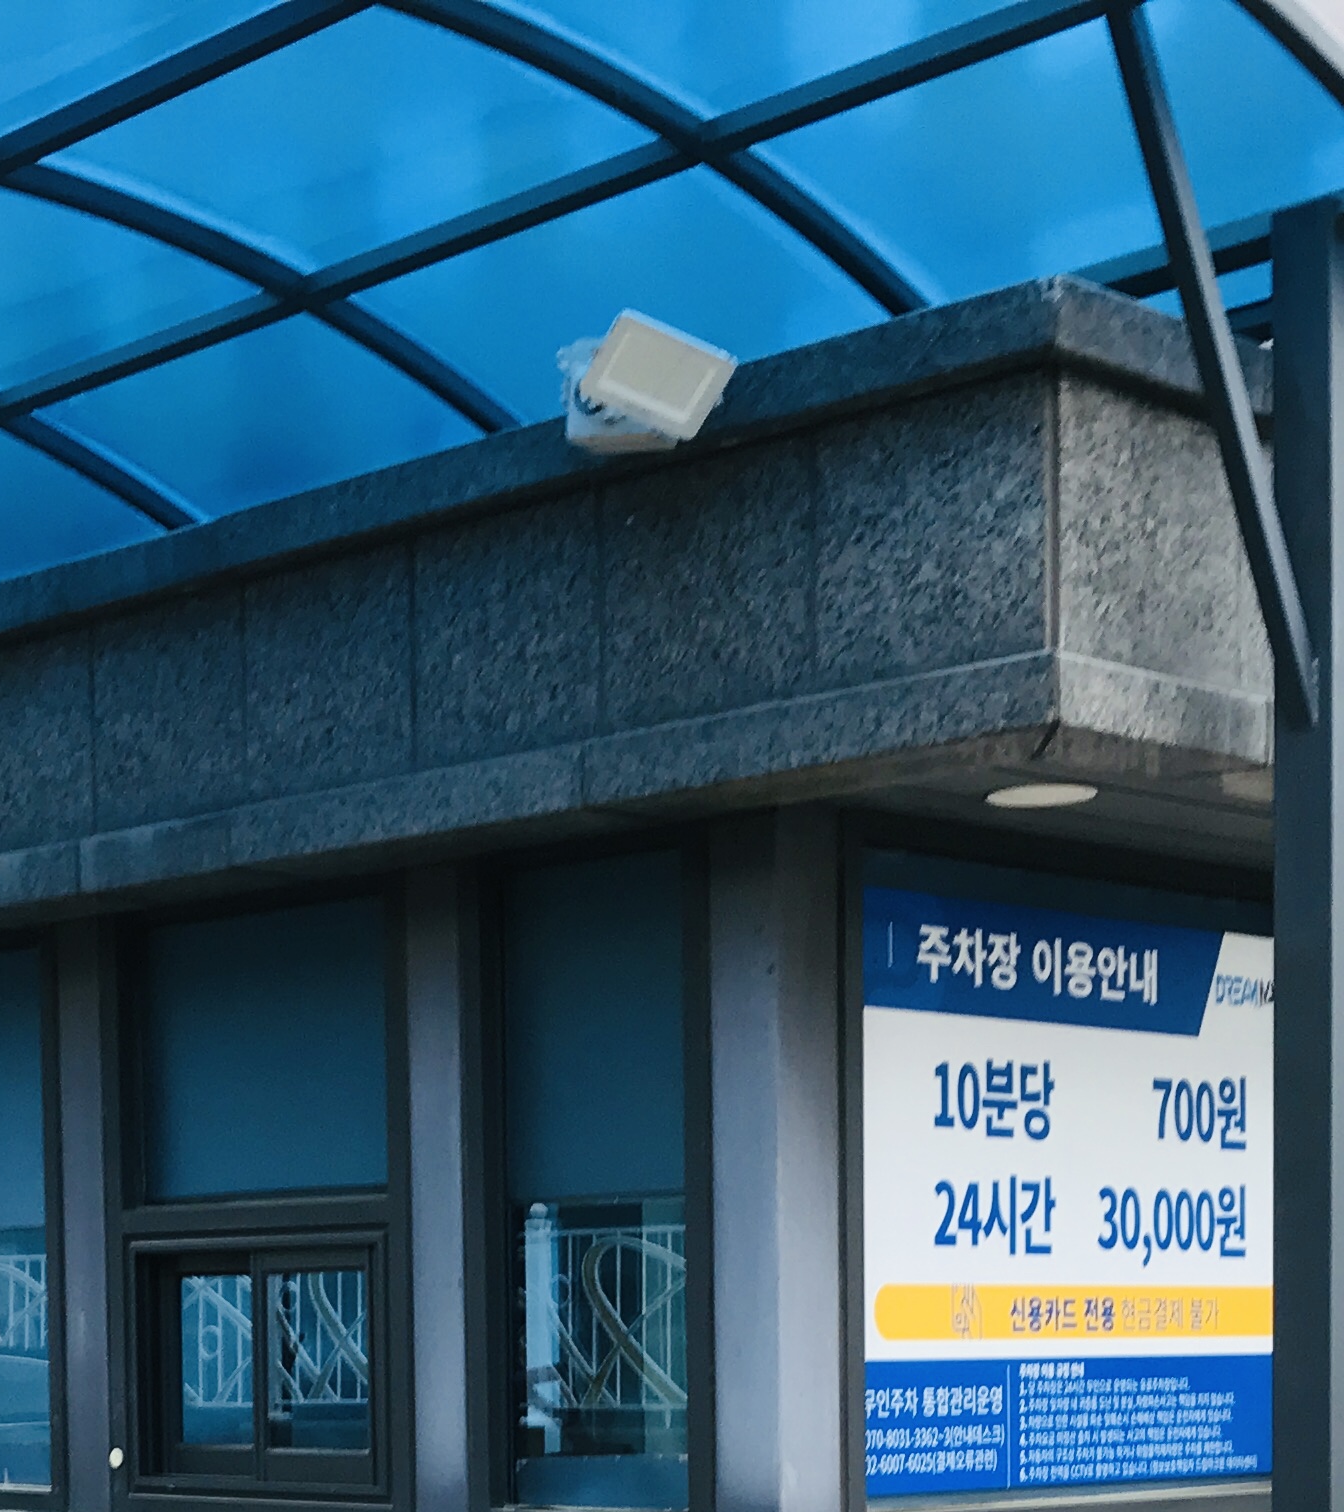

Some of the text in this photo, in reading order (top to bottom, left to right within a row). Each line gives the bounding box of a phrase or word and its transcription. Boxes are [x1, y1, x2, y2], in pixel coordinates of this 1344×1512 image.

[917, 924, 1158, 1006] 주차장 이용안내
[933, 1058, 1247, 1151] 10분당 700원
[934, 1175, 1247, 1267] 24시간 30,000원
[1010, 1296, 1220, 1332] 신용카드 전용 현금결제 불가
[922, 1384, 1003, 1418] 통합관리운영
